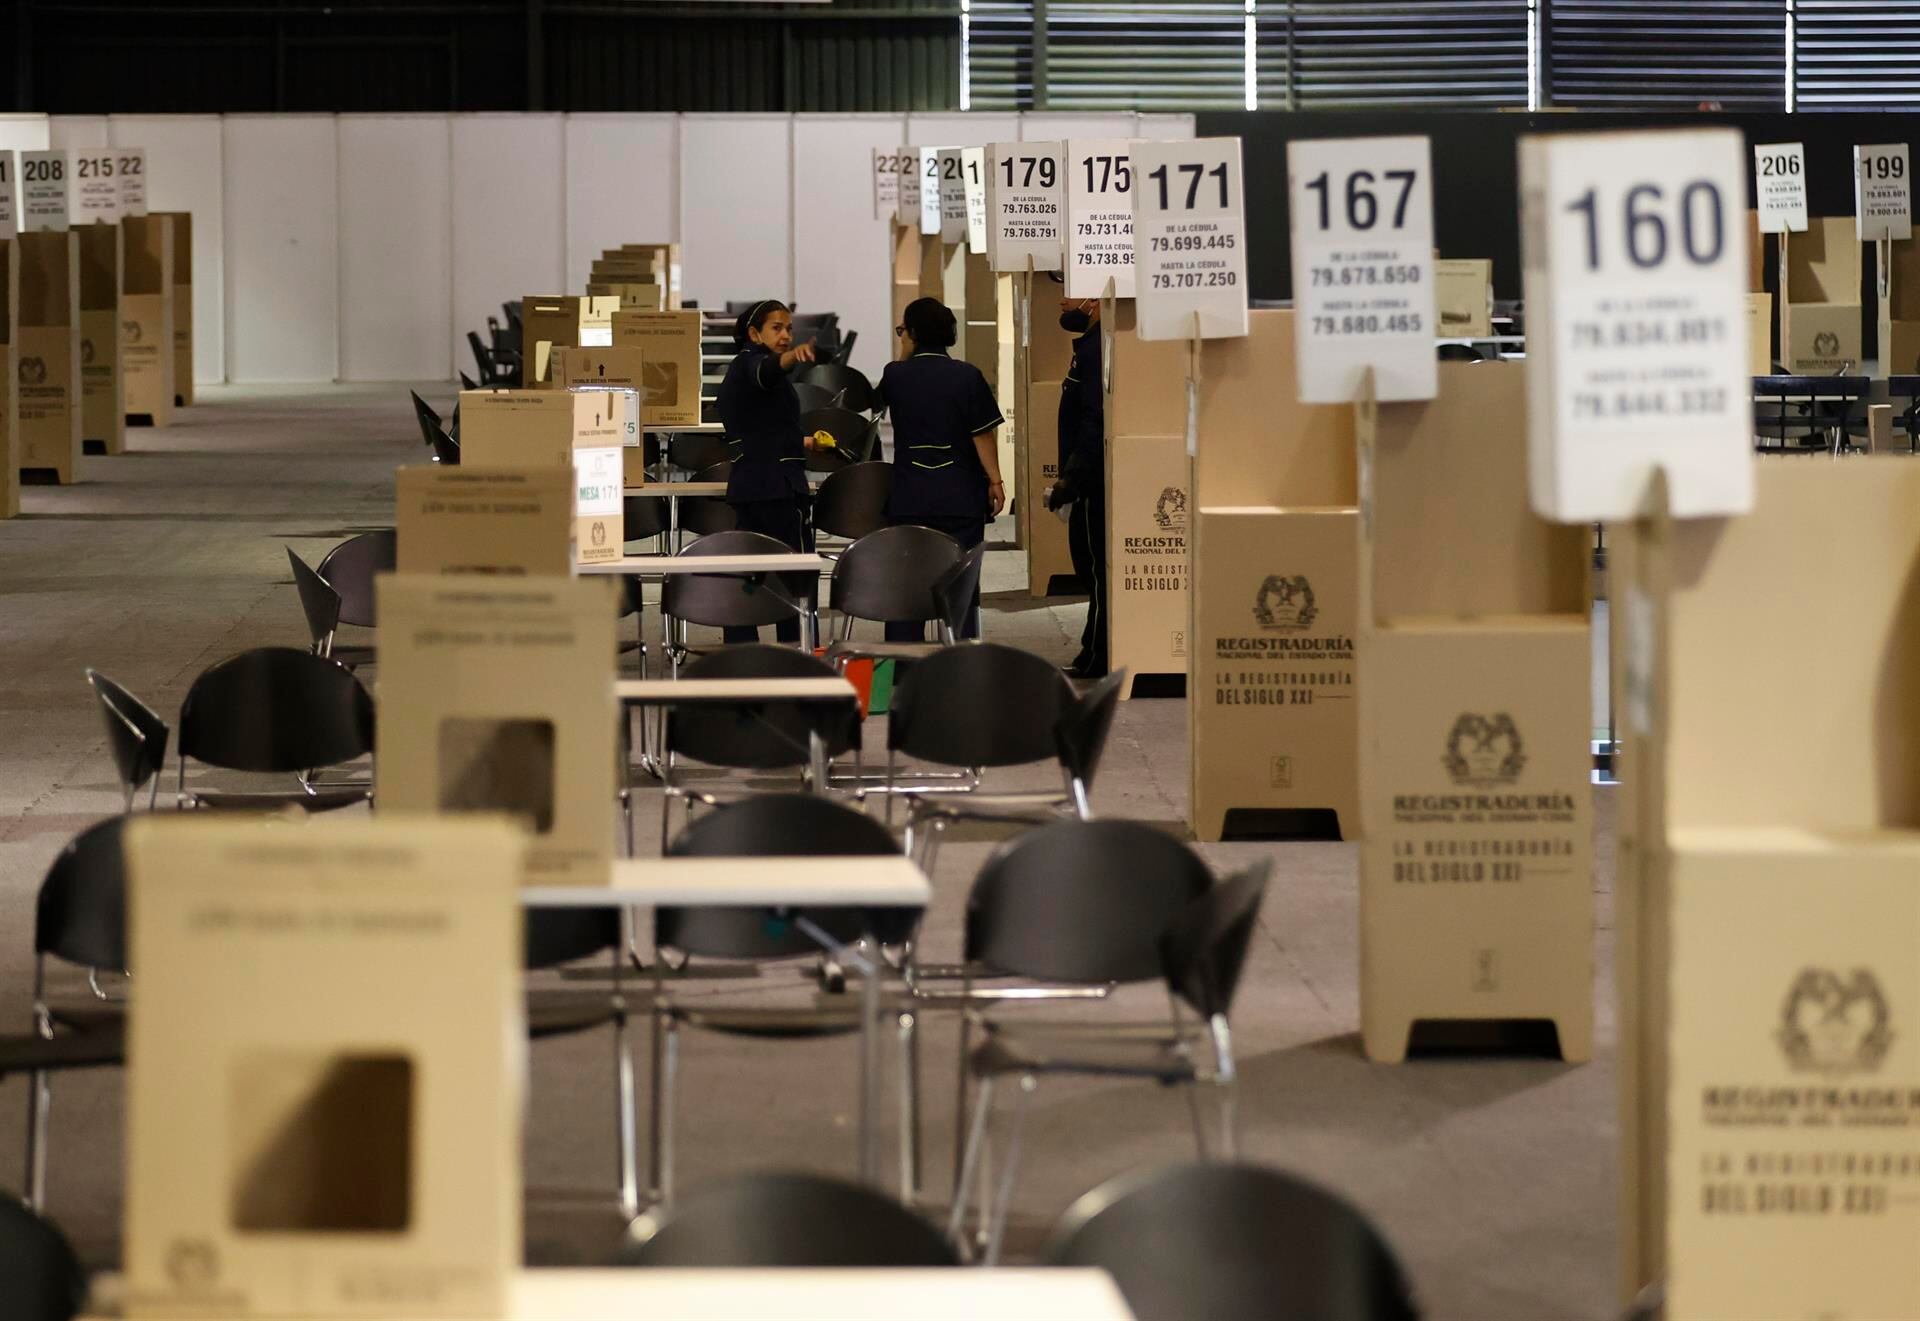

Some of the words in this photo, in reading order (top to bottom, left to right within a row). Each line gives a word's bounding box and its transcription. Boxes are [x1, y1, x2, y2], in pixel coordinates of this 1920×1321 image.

[24, 160, 63, 181] 208
[78, 158, 114, 177] 215
[902, 156, 919, 175] 2
[1001, 156, 1056, 188] 179
[1082, 155, 1131, 193] 175
[1762, 154, 1801, 177] 206
[1862, 155, 1904, 180] 199
[1148, 162, 1229, 210] 171
[1002, 204, 1057, 214] 79.763.026
[1304, 170, 1417, 231] 167
[1003, 228, 1057, 238] 79.768.791
[1166, 225, 1175, 233] DE
[1564, 180, 1725, 272] 160
[1114, 242, 1133, 250] CÉDUL
[1151, 235, 1235, 252] 79.699.445
[1161, 261, 1184, 270] HASTA
[1186, 261, 1195, 269] LA
[1152, 271, 1237, 289] 79.707.250
[579, 486, 600, 500] MESA
[602, 485, 618, 499] 171
[1125, 565, 1137, 575] LA
[1125, 578, 1144, 591] DEL
[1147, 578, 1179, 591] SIGLO
[1216, 635, 1354, 650] REGISTRADURÍA
[1216, 673, 1231, 685] LA
[1216, 689, 1240, 705] DEL
[1244, 689, 1284, 705] SIGLO
[1290, 689, 1313, 705] XXI
